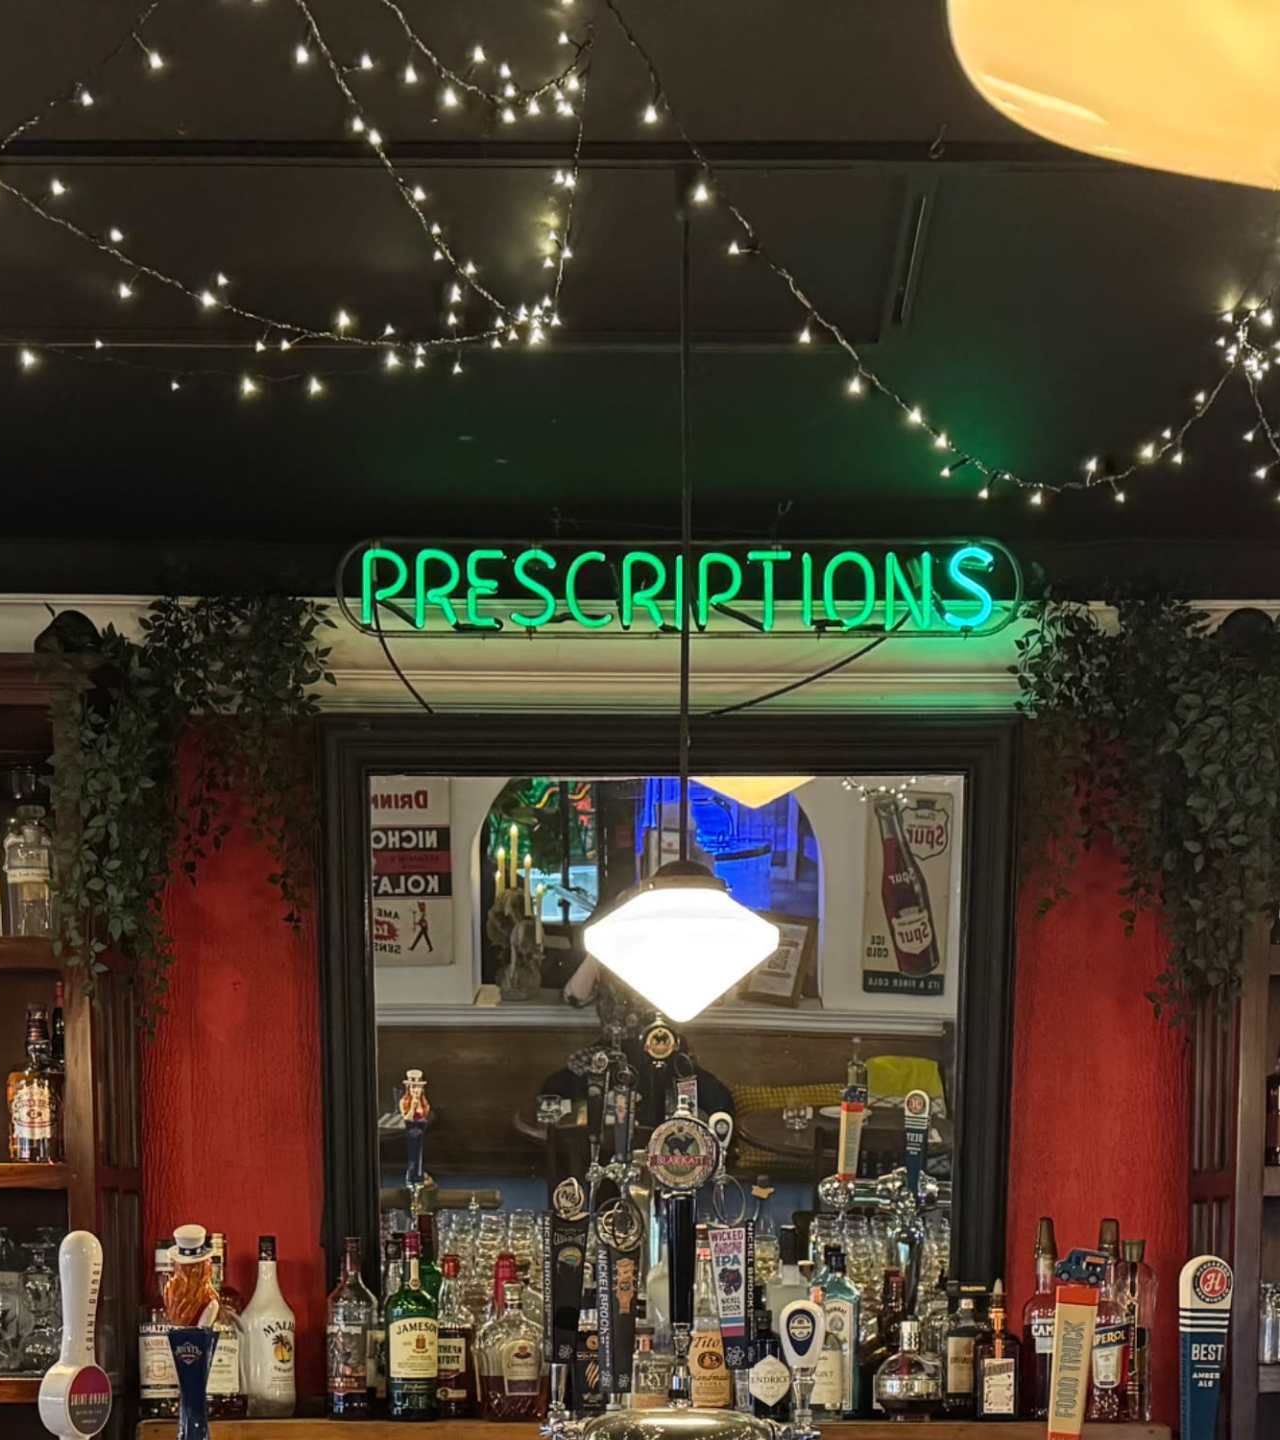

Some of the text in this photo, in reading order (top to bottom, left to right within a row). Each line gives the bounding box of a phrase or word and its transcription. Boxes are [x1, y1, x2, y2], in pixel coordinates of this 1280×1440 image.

[360, 546, 995, 632] PRESCRIPTIONS
[711, 1230, 744, 1241] WICKED
[716, 1255, 741, 1267] IPA
[1192, 1344, 1224, 1361] BEST
[1055, 1320, 1086, 1419] FOOD TRUCK
